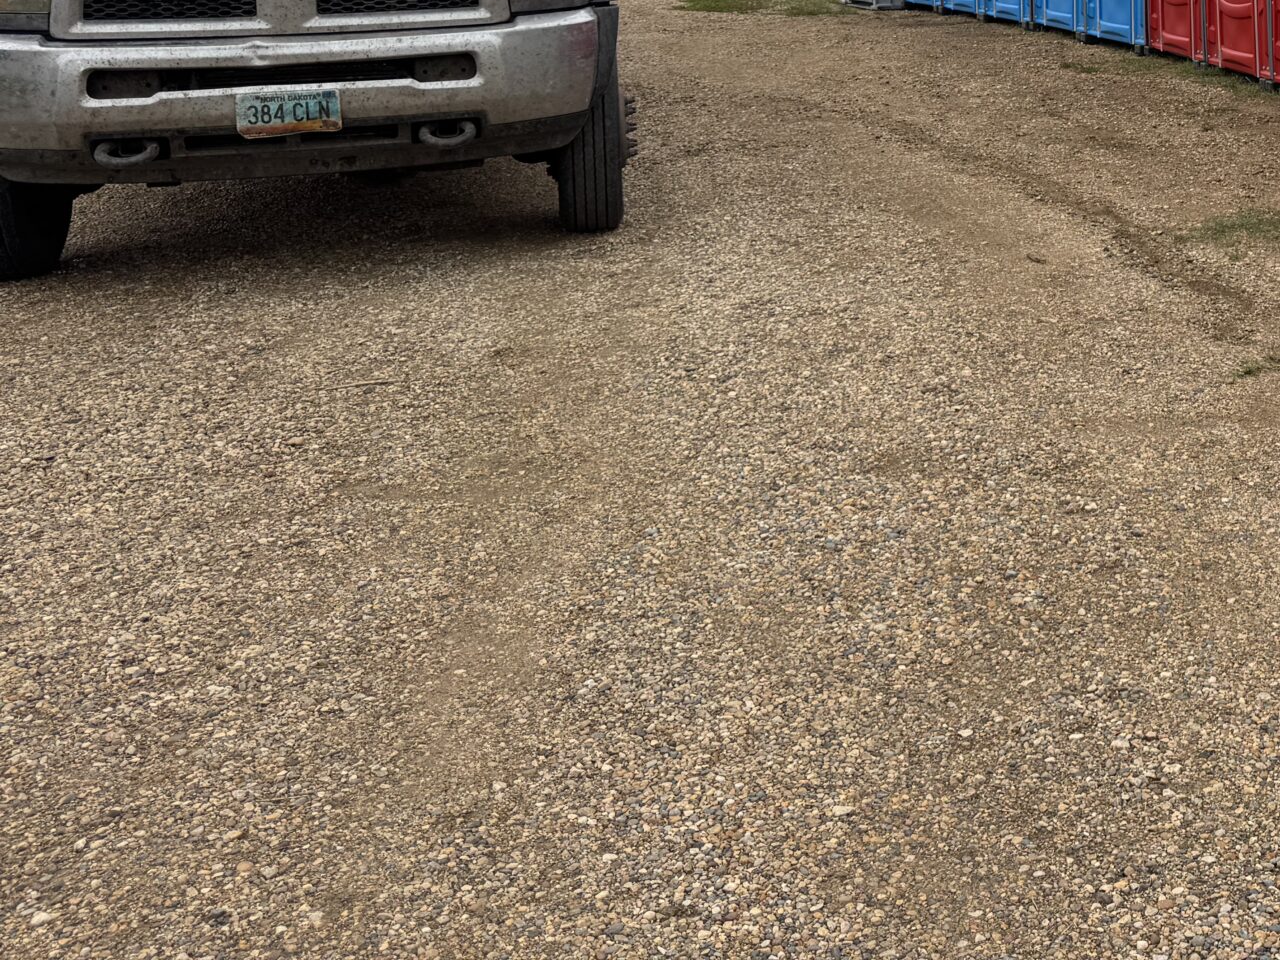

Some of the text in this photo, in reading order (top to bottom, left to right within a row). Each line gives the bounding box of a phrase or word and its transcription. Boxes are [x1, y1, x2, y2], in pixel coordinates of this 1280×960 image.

[287, 93, 318, 102] DAKOTA
[247, 101, 331, 125] 384 CLN
